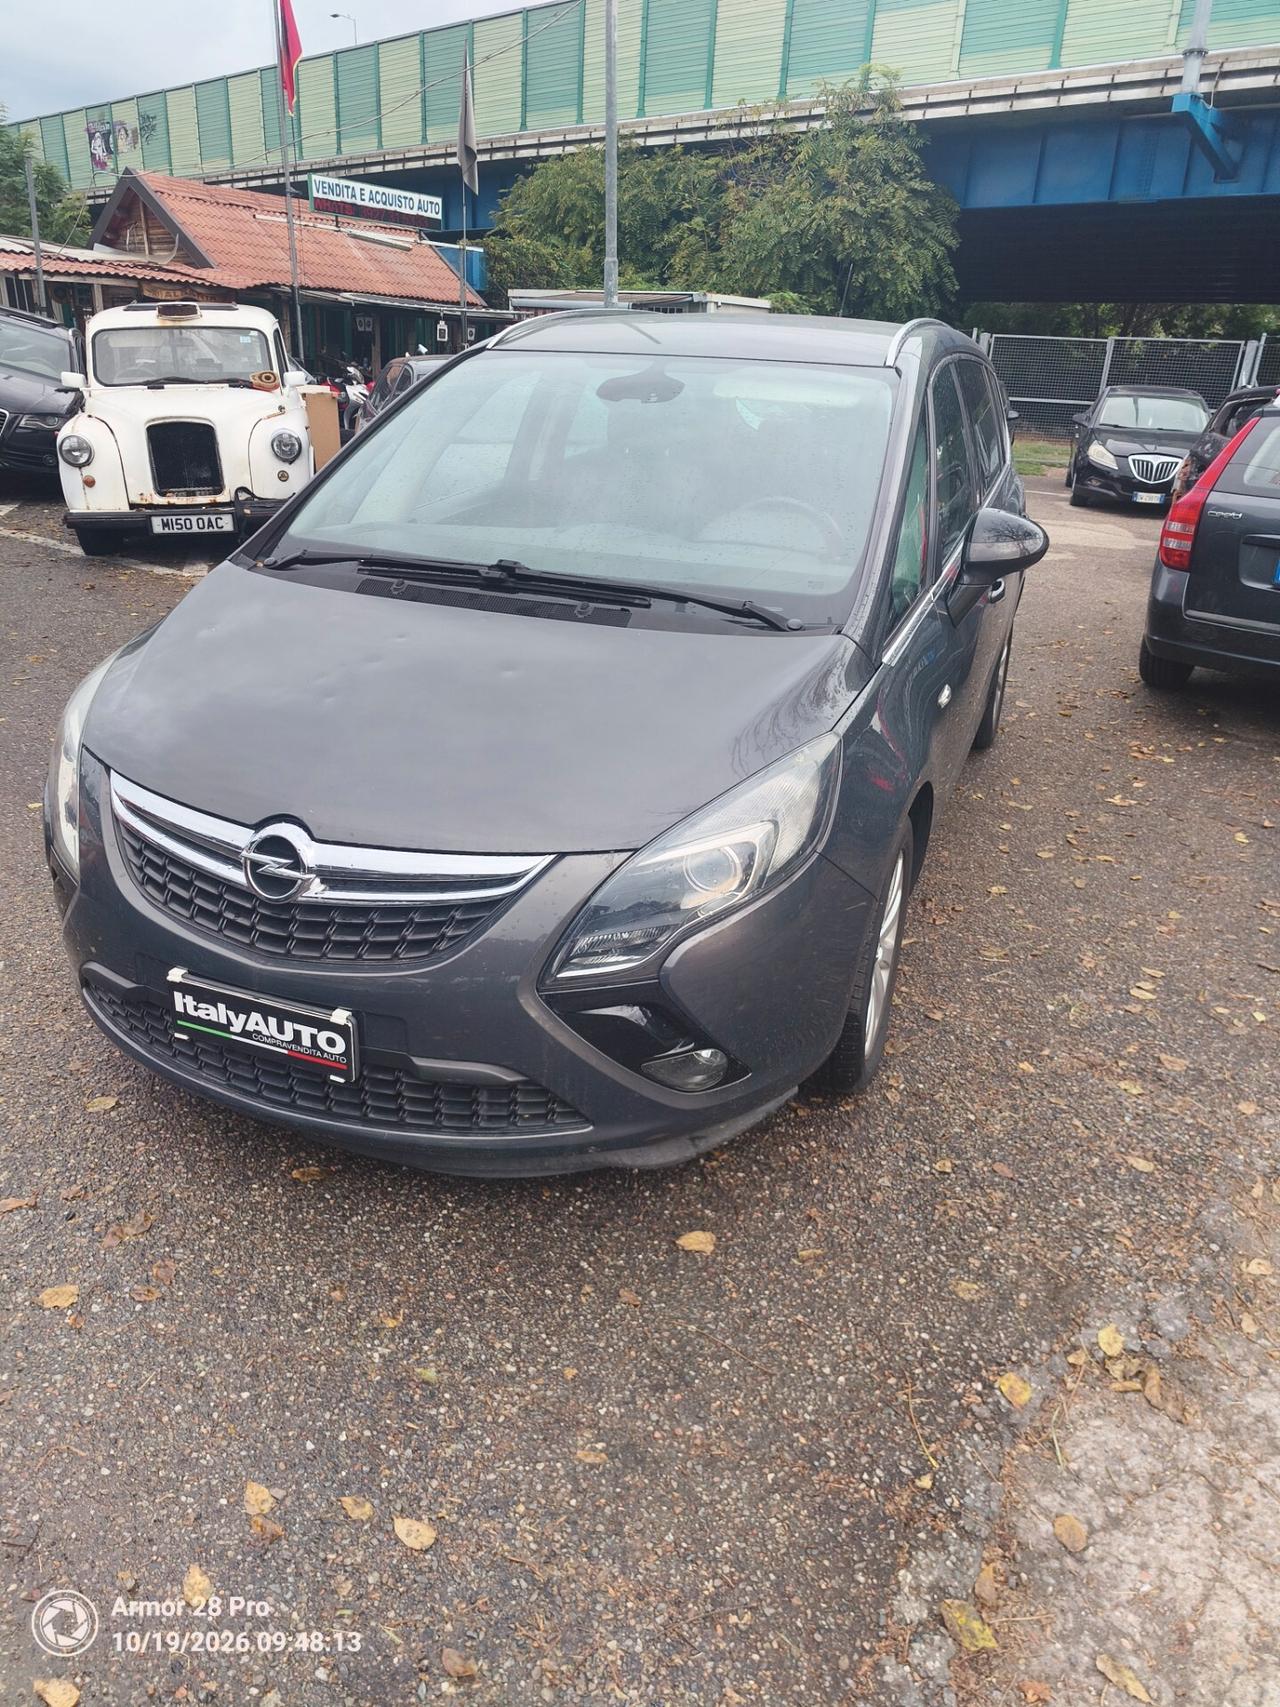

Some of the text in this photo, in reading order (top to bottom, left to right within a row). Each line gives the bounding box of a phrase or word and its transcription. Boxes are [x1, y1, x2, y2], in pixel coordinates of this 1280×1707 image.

[314, 178, 441, 216] VENDITA E ACQUISTO AUTO
[196, 517, 224, 530] OAC
[173, 991, 346, 1055] ItalyAUTO
[252, 1033, 347, 1064] COMPRAVENDITA AUTO
